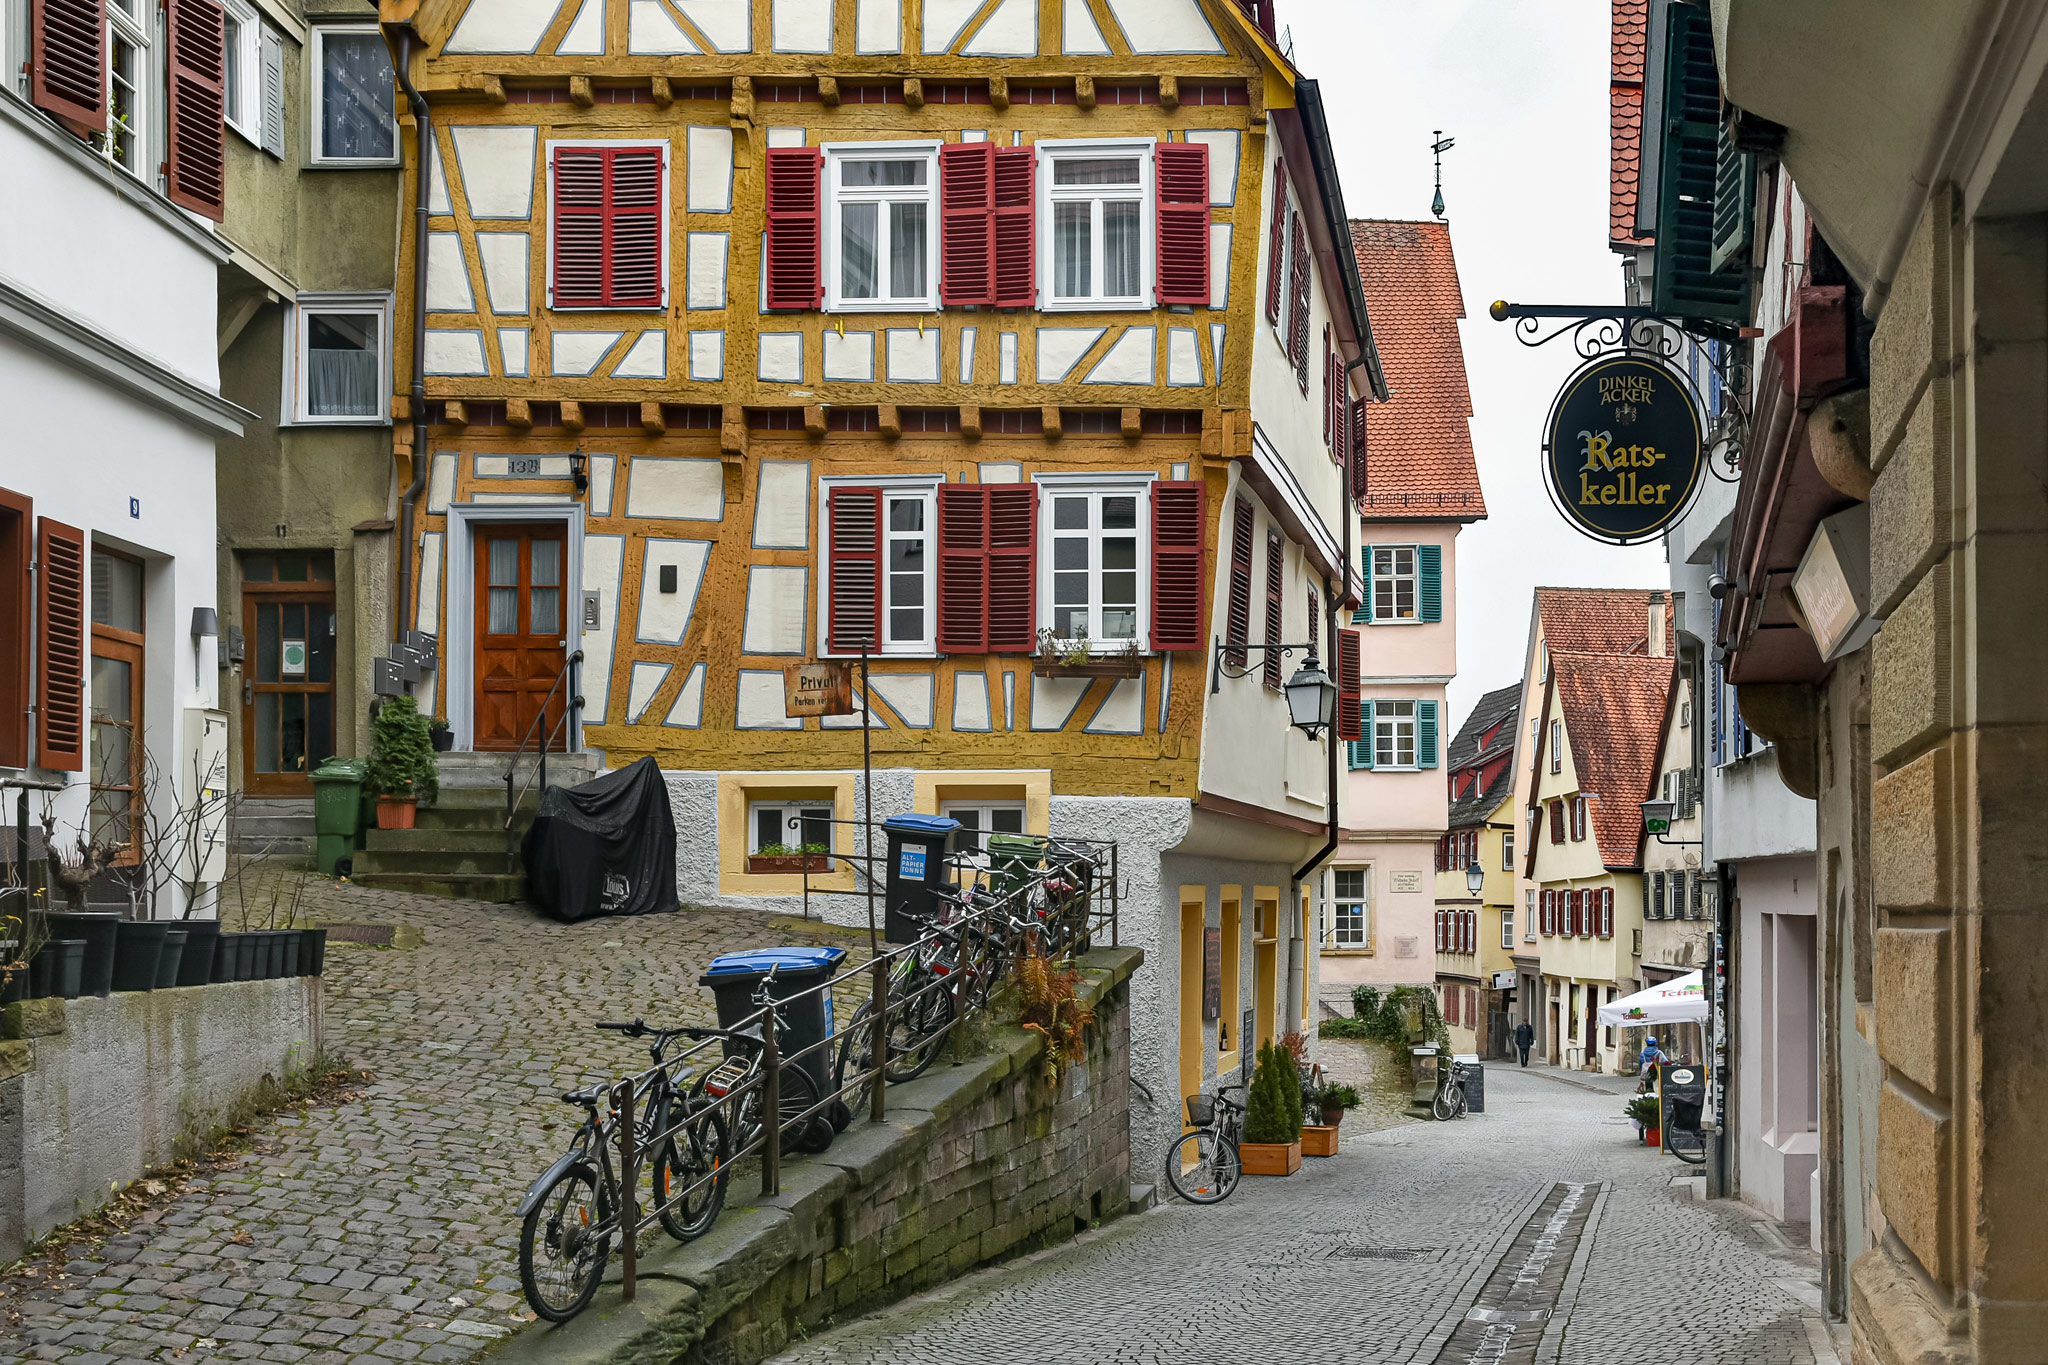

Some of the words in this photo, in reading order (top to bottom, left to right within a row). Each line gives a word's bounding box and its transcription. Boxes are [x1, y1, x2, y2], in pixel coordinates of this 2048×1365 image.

[1598, 375, 1656, 393] DINKEL
[1600, 388, 1653, 405] ACKER
[1577, 430, 1666, 472] Rats-
[1578, 471, 1671, 505] keller
[132, 500, 138, 515] 9
[275, 524, 287, 538] 11
[901, 860, 924, 868] PAPIER
[901, 866, 924, 875] TONNE
[606, 876, 624, 895] Louis
